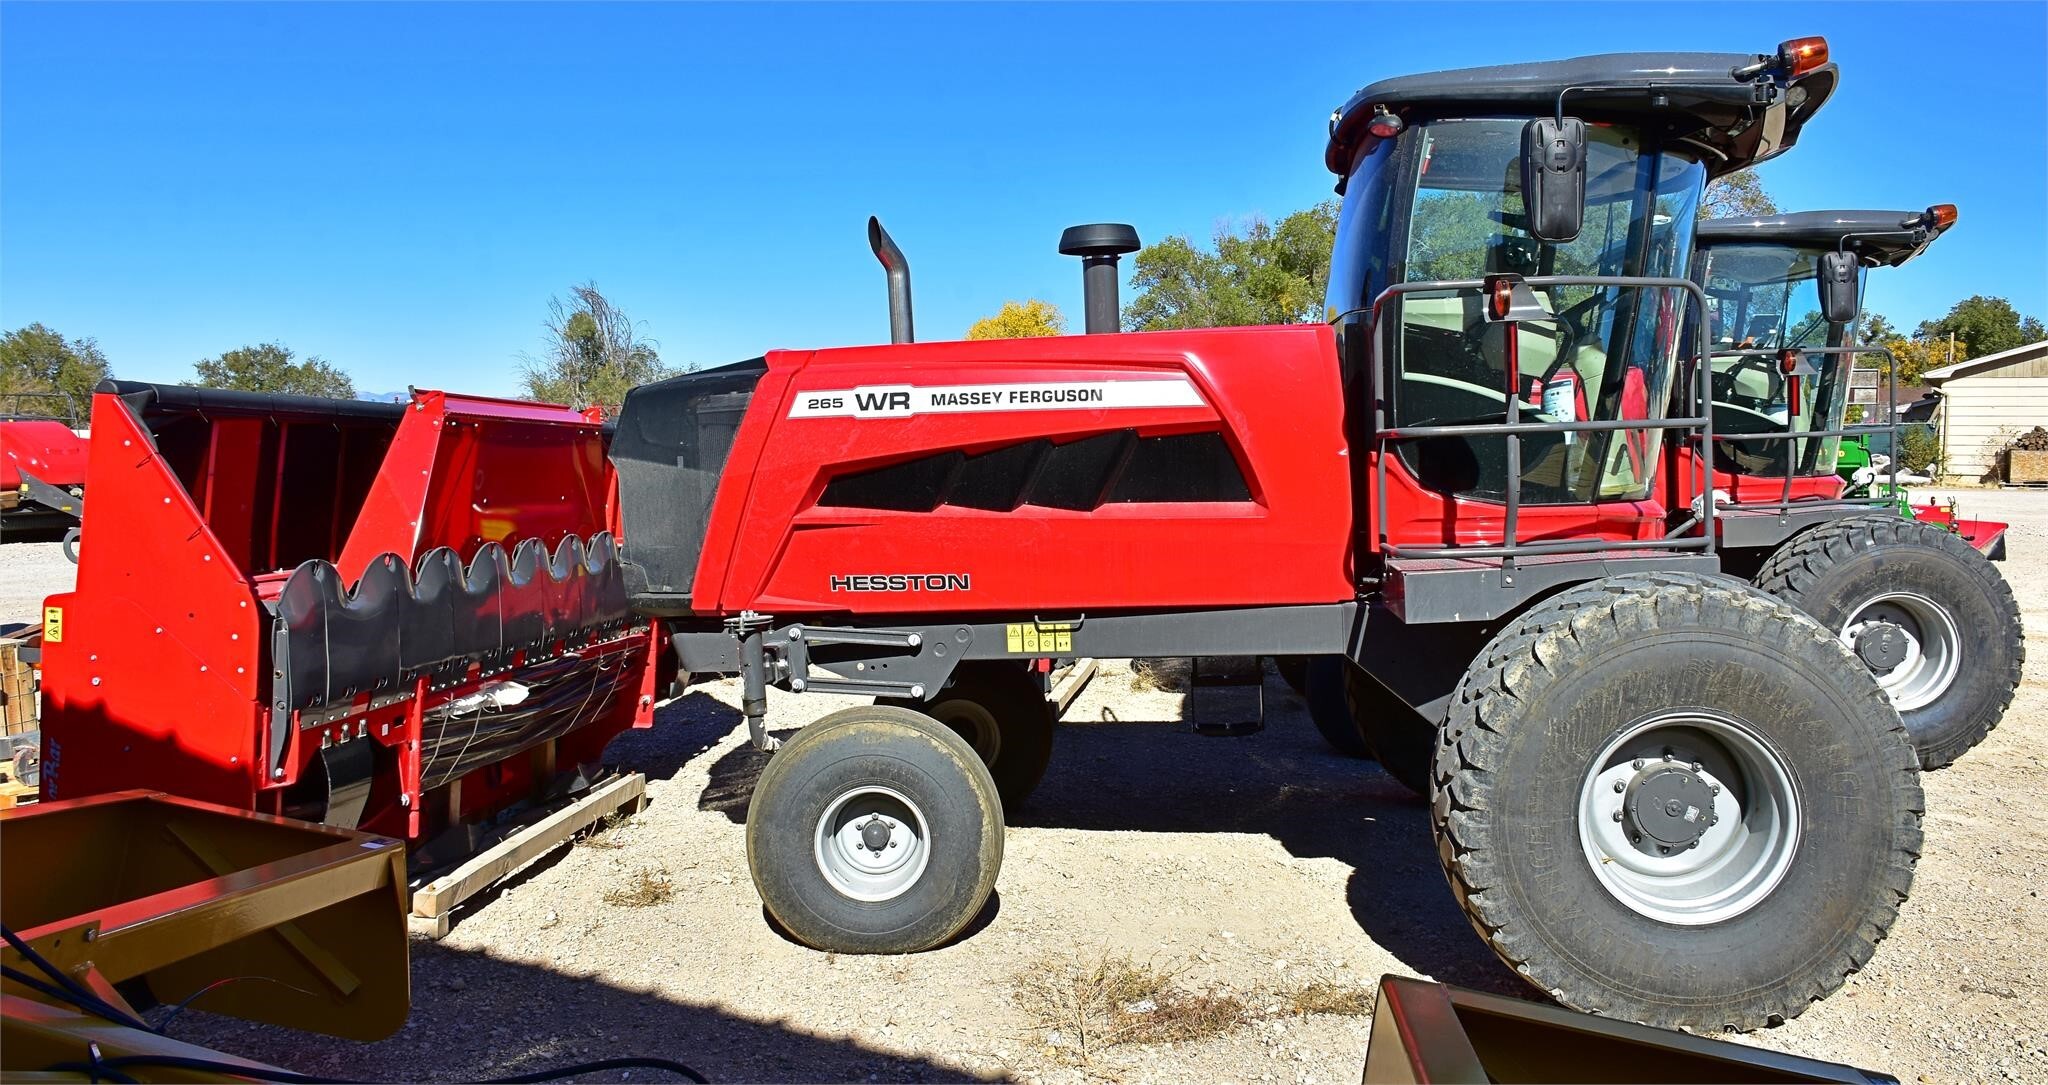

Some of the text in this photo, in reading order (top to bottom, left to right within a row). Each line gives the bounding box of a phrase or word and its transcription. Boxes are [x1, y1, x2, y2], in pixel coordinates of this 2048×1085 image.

[808, 388, 1103, 411] 265 WR MASSEY FERGUSON
[830, 573, 971, 592] HESSTON
